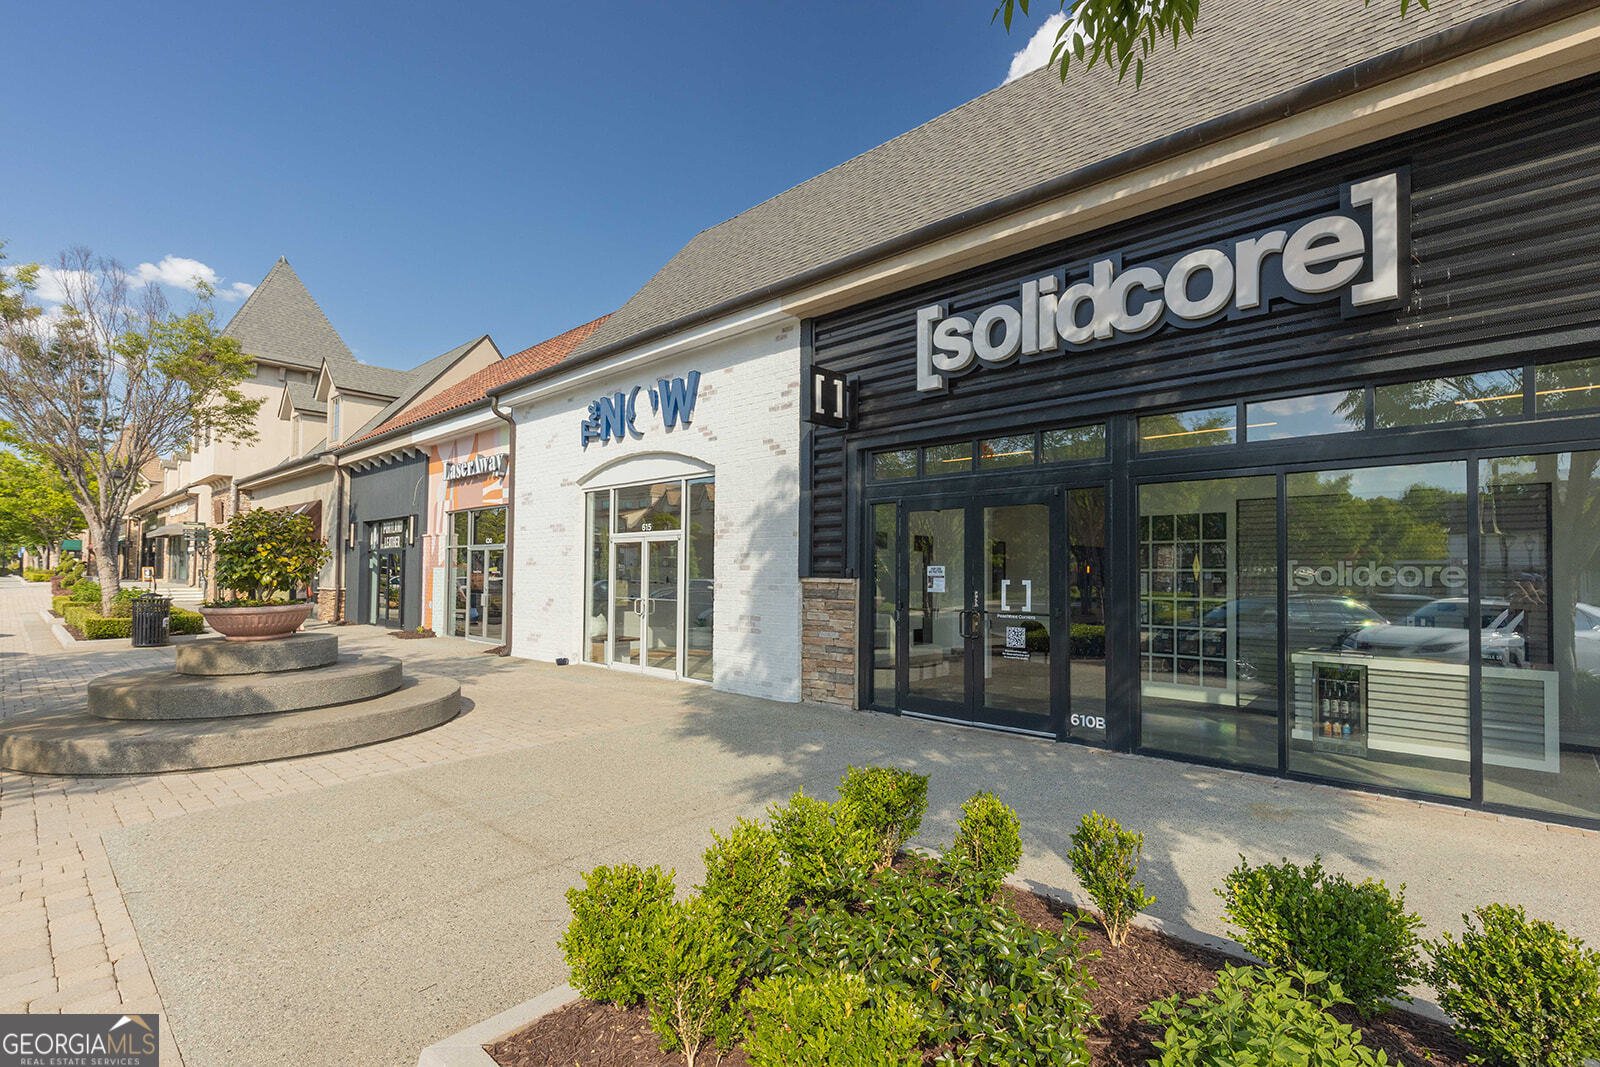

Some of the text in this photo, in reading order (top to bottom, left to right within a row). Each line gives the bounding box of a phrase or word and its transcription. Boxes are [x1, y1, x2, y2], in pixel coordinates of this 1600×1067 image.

[441, 453, 505, 480] LaserAway
[641, 523, 652, 531] 615
[1287, 560, 1468, 591] [solidcore
[1070, 713, 1106, 729] 610B
